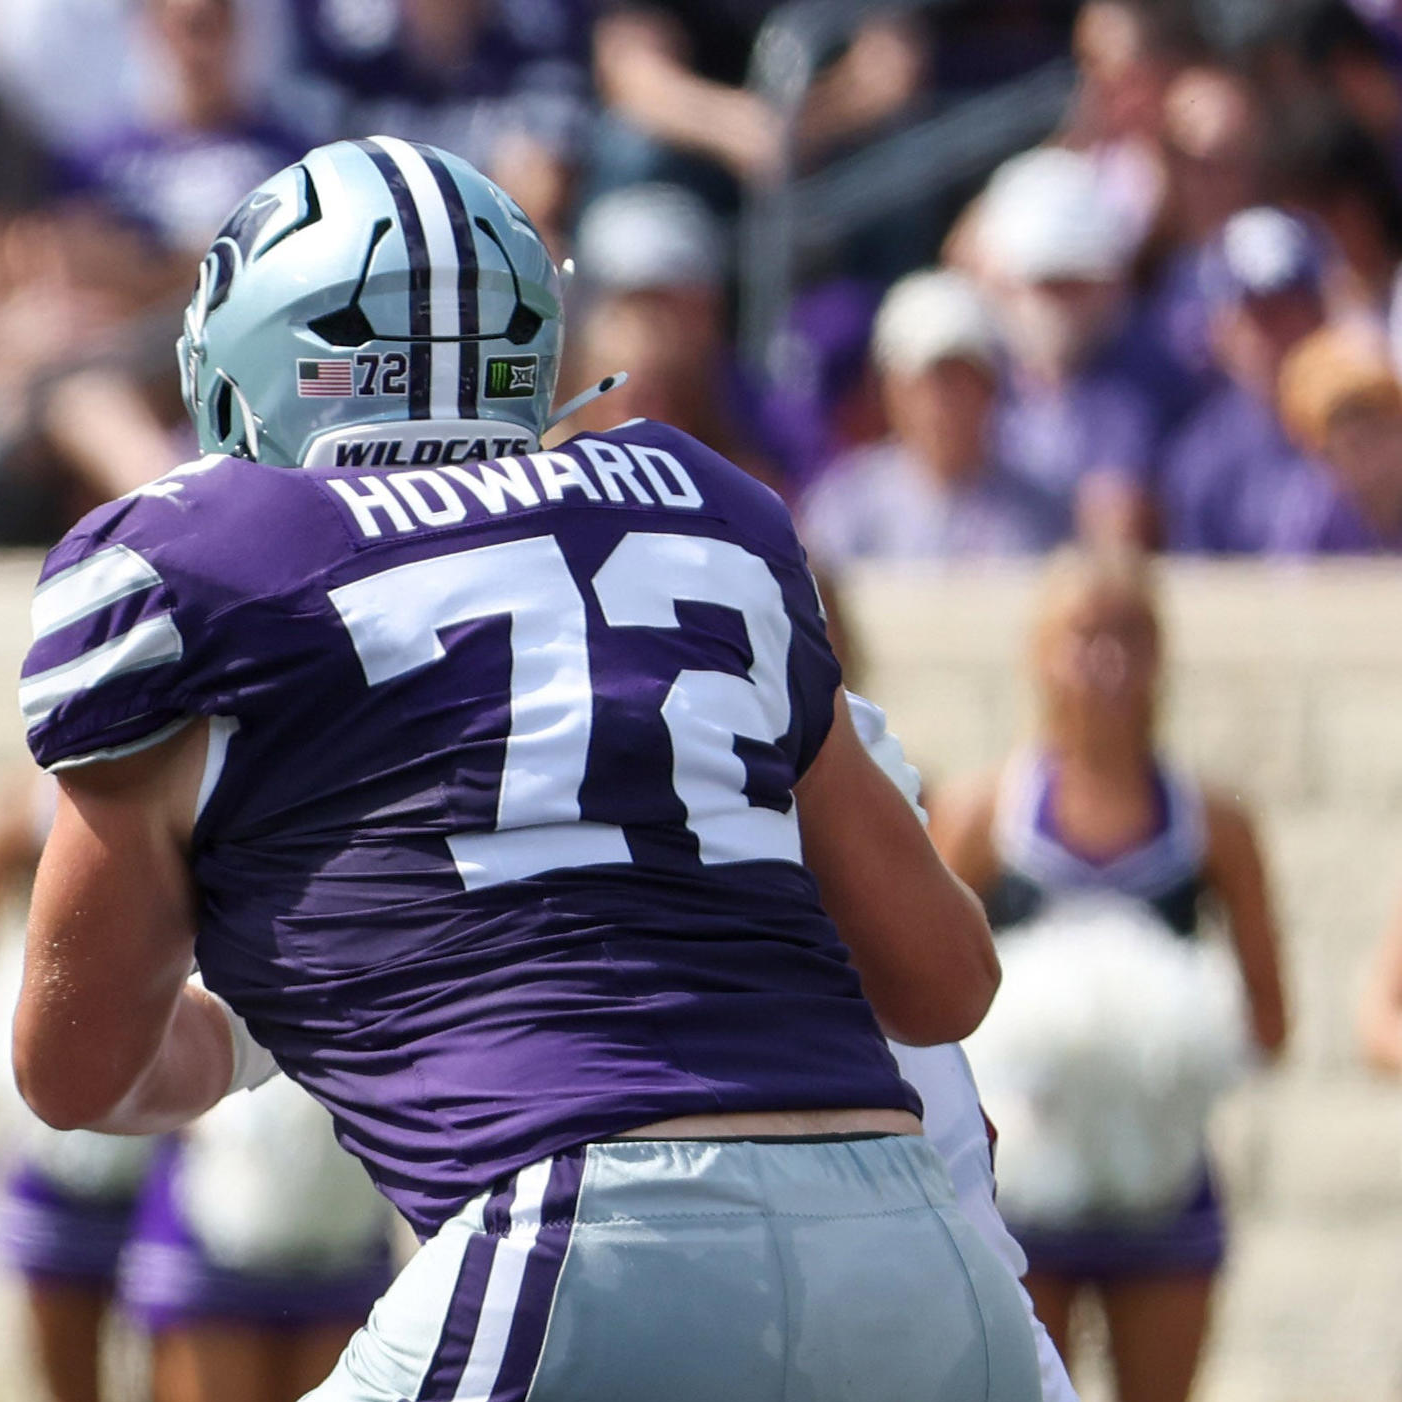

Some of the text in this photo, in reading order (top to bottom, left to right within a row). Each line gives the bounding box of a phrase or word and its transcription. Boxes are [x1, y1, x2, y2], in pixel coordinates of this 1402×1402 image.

[353, 352, 411, 397] 72
[326, 438, 705, 538] HOWARD
[335, 438, 529, 467] WILDCATS
[327, 531, 803, 892] 72
